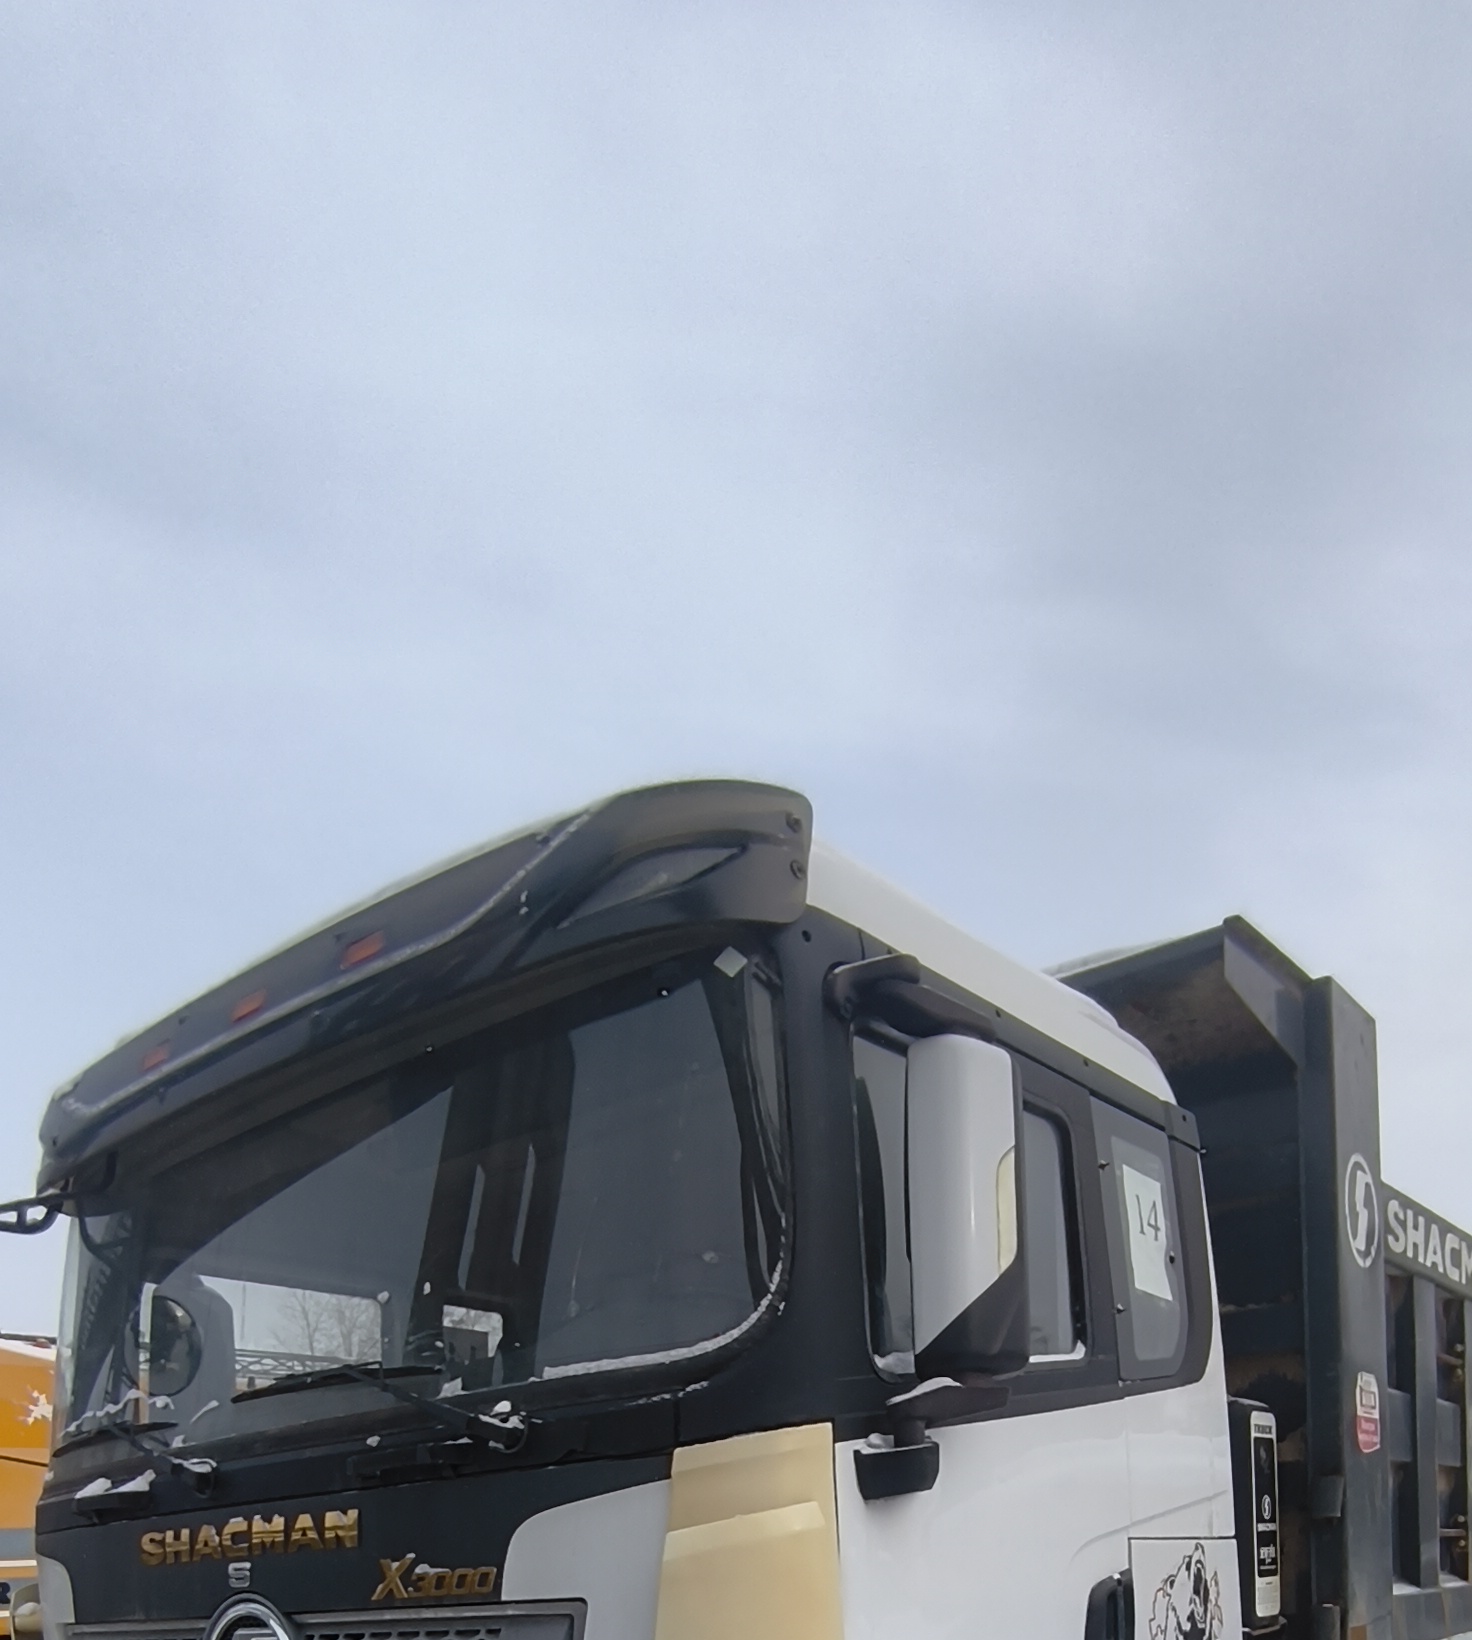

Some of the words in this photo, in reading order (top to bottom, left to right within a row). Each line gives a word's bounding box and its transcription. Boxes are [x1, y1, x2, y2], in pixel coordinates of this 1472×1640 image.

[1135, 1193, 1161, 1242] 14
[139, 1508, 359, 1566] SHACMAN
[228, 1561, 251, 1588] S
[371, 1552, 497, 1600] X3000
